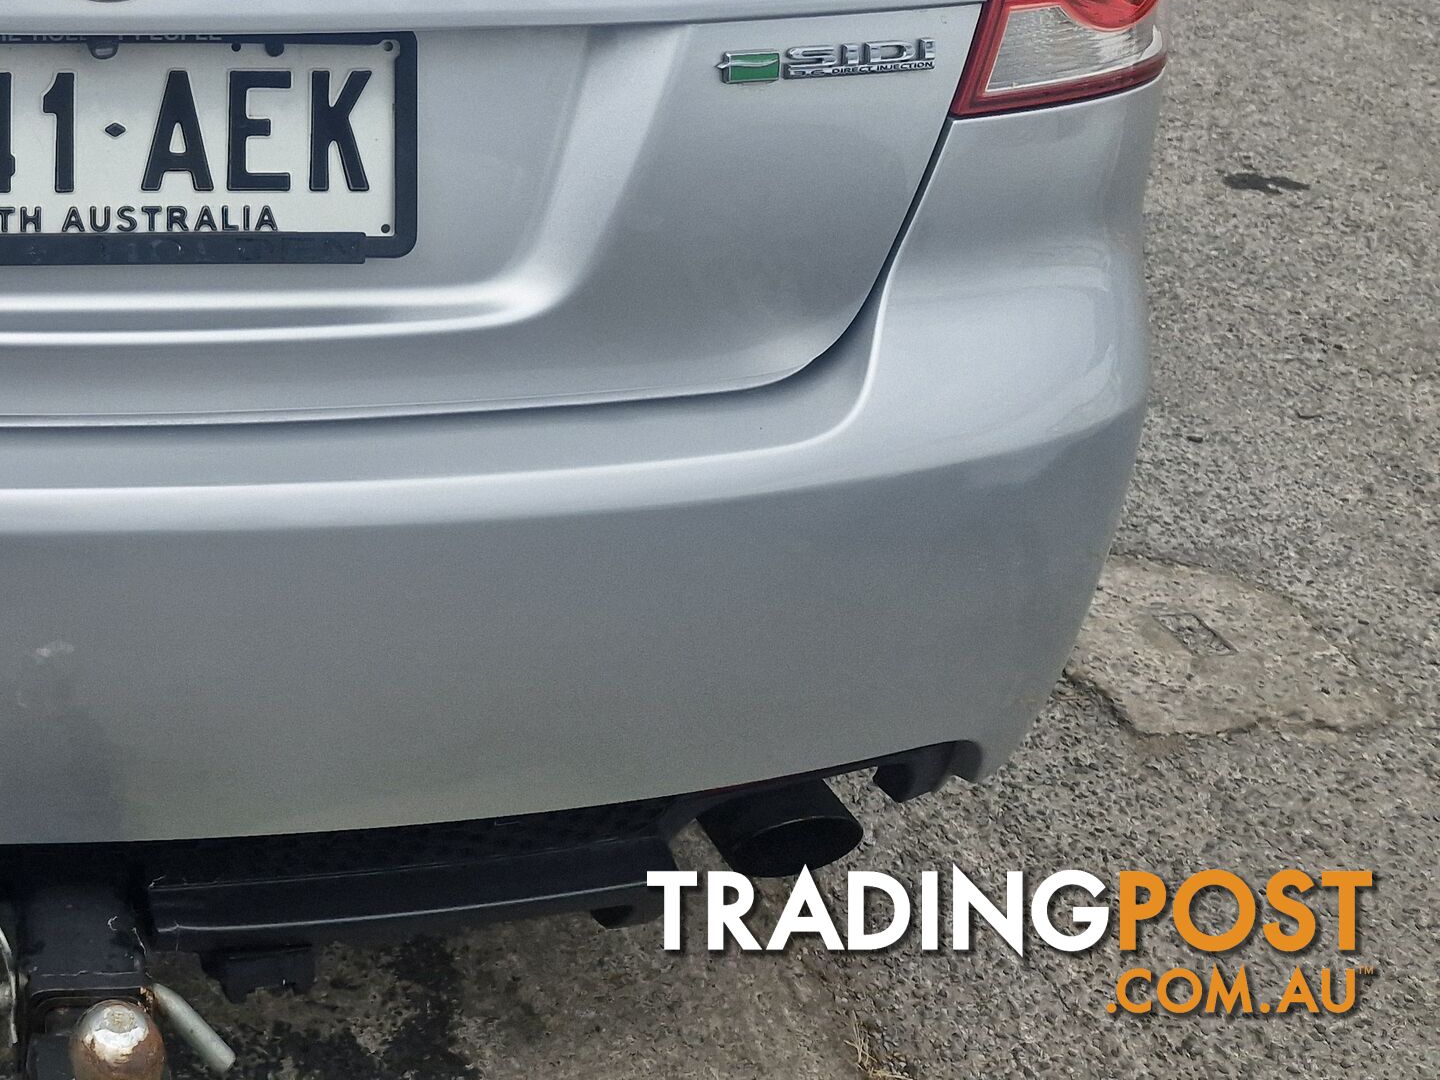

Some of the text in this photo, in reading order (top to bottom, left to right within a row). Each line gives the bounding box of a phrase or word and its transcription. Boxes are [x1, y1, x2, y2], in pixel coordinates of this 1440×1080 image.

[831, 65, 875, 75] DIRECT
[876, 60, 934, 71] INJECTION
[61, 204, 280, 233] AUSTRALIA
